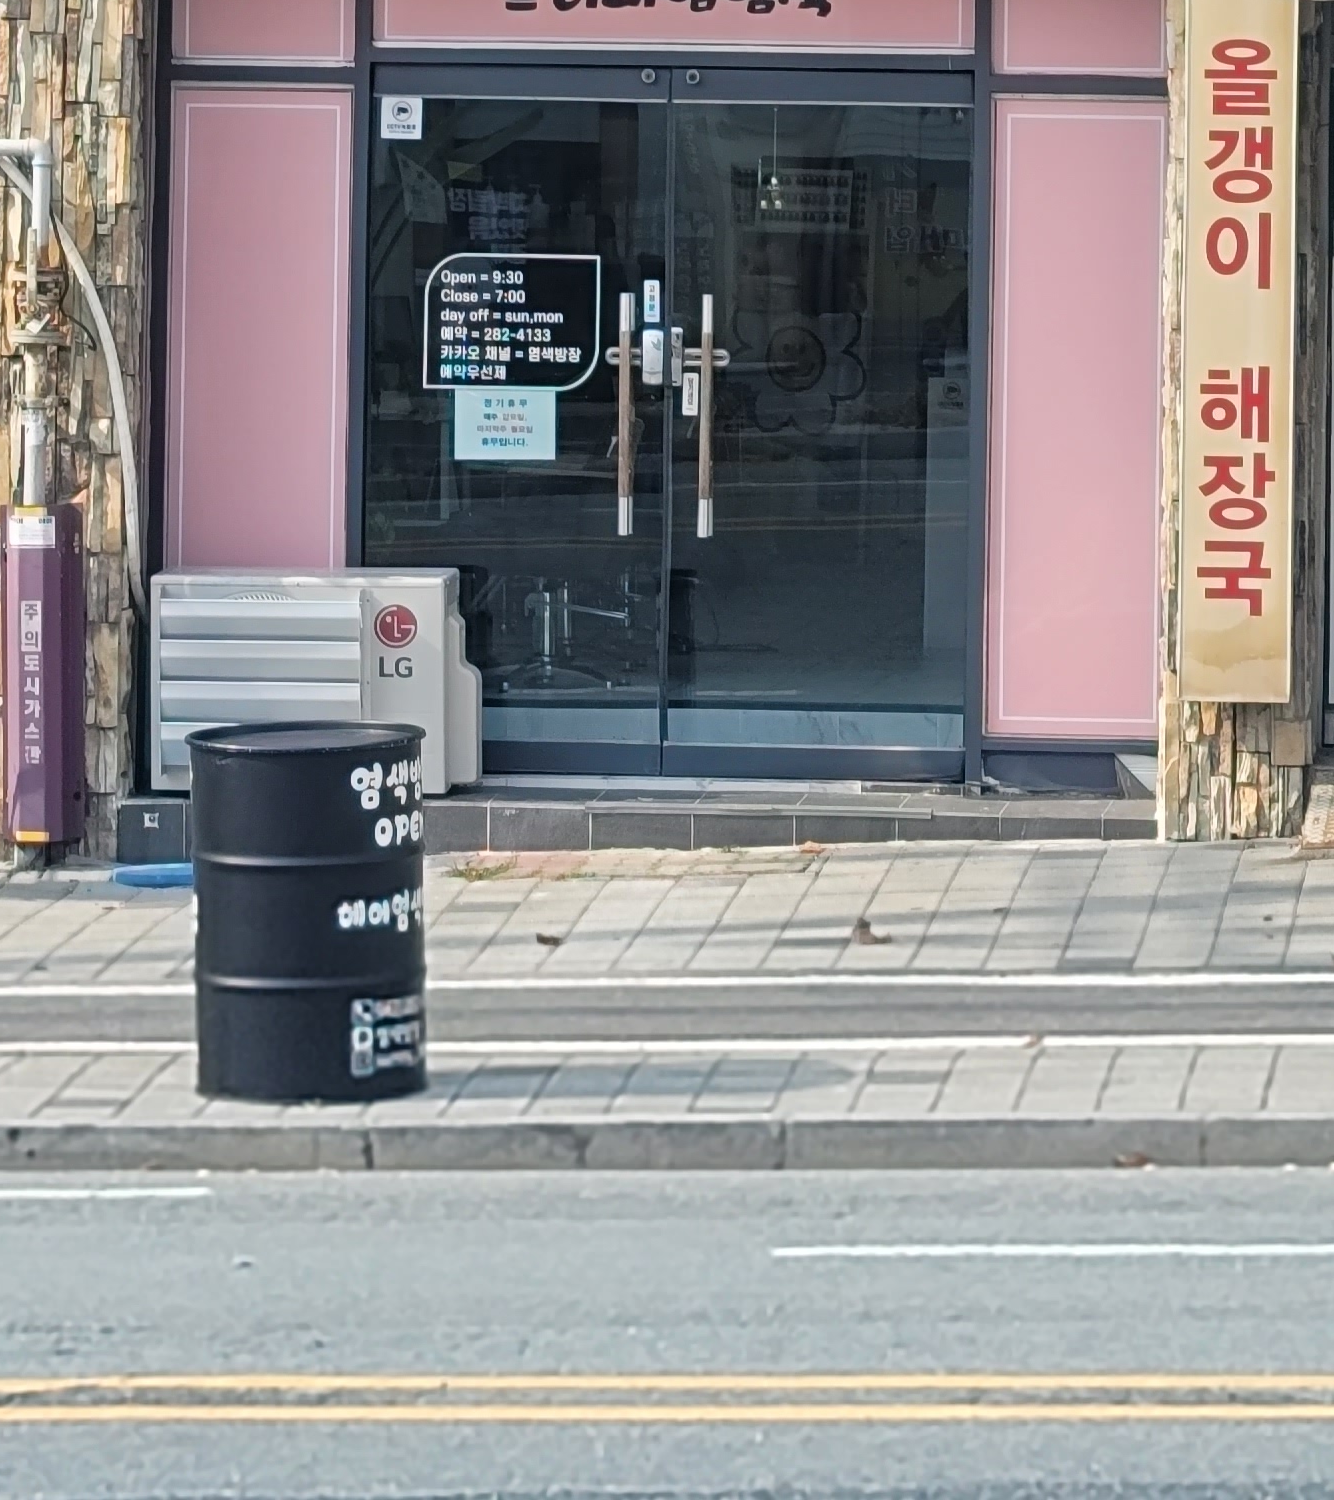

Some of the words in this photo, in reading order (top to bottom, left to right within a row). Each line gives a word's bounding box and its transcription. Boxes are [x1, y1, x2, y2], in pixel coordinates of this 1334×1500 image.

[1203, 38, 1278, 290] 올갱이
[440, 270, 476, 285] Open
[492, 270, 524, 285] 9:30
[440, 289, 479, 303] Close
[495, 289, 526, 304] 7:00
[440, 308, 465, 324] day
[469, 308, 490, 322] off
[505, 311, 564, 324] sun,mon
[440, 326, 468, 341] 예약
[483, 328, 551, 342] 282-4133
[440, 345, 480, 361] 카카오
[485, 345, 511, 362] 채널
[528, 347, 582, 362] 염색방장
[440, 364, 507, 380] 예약우선제
[1195, 365, 1276, 618] 해장국
[24, 603, 41, 650] 주의
[378, 657, 414, 678] LG
